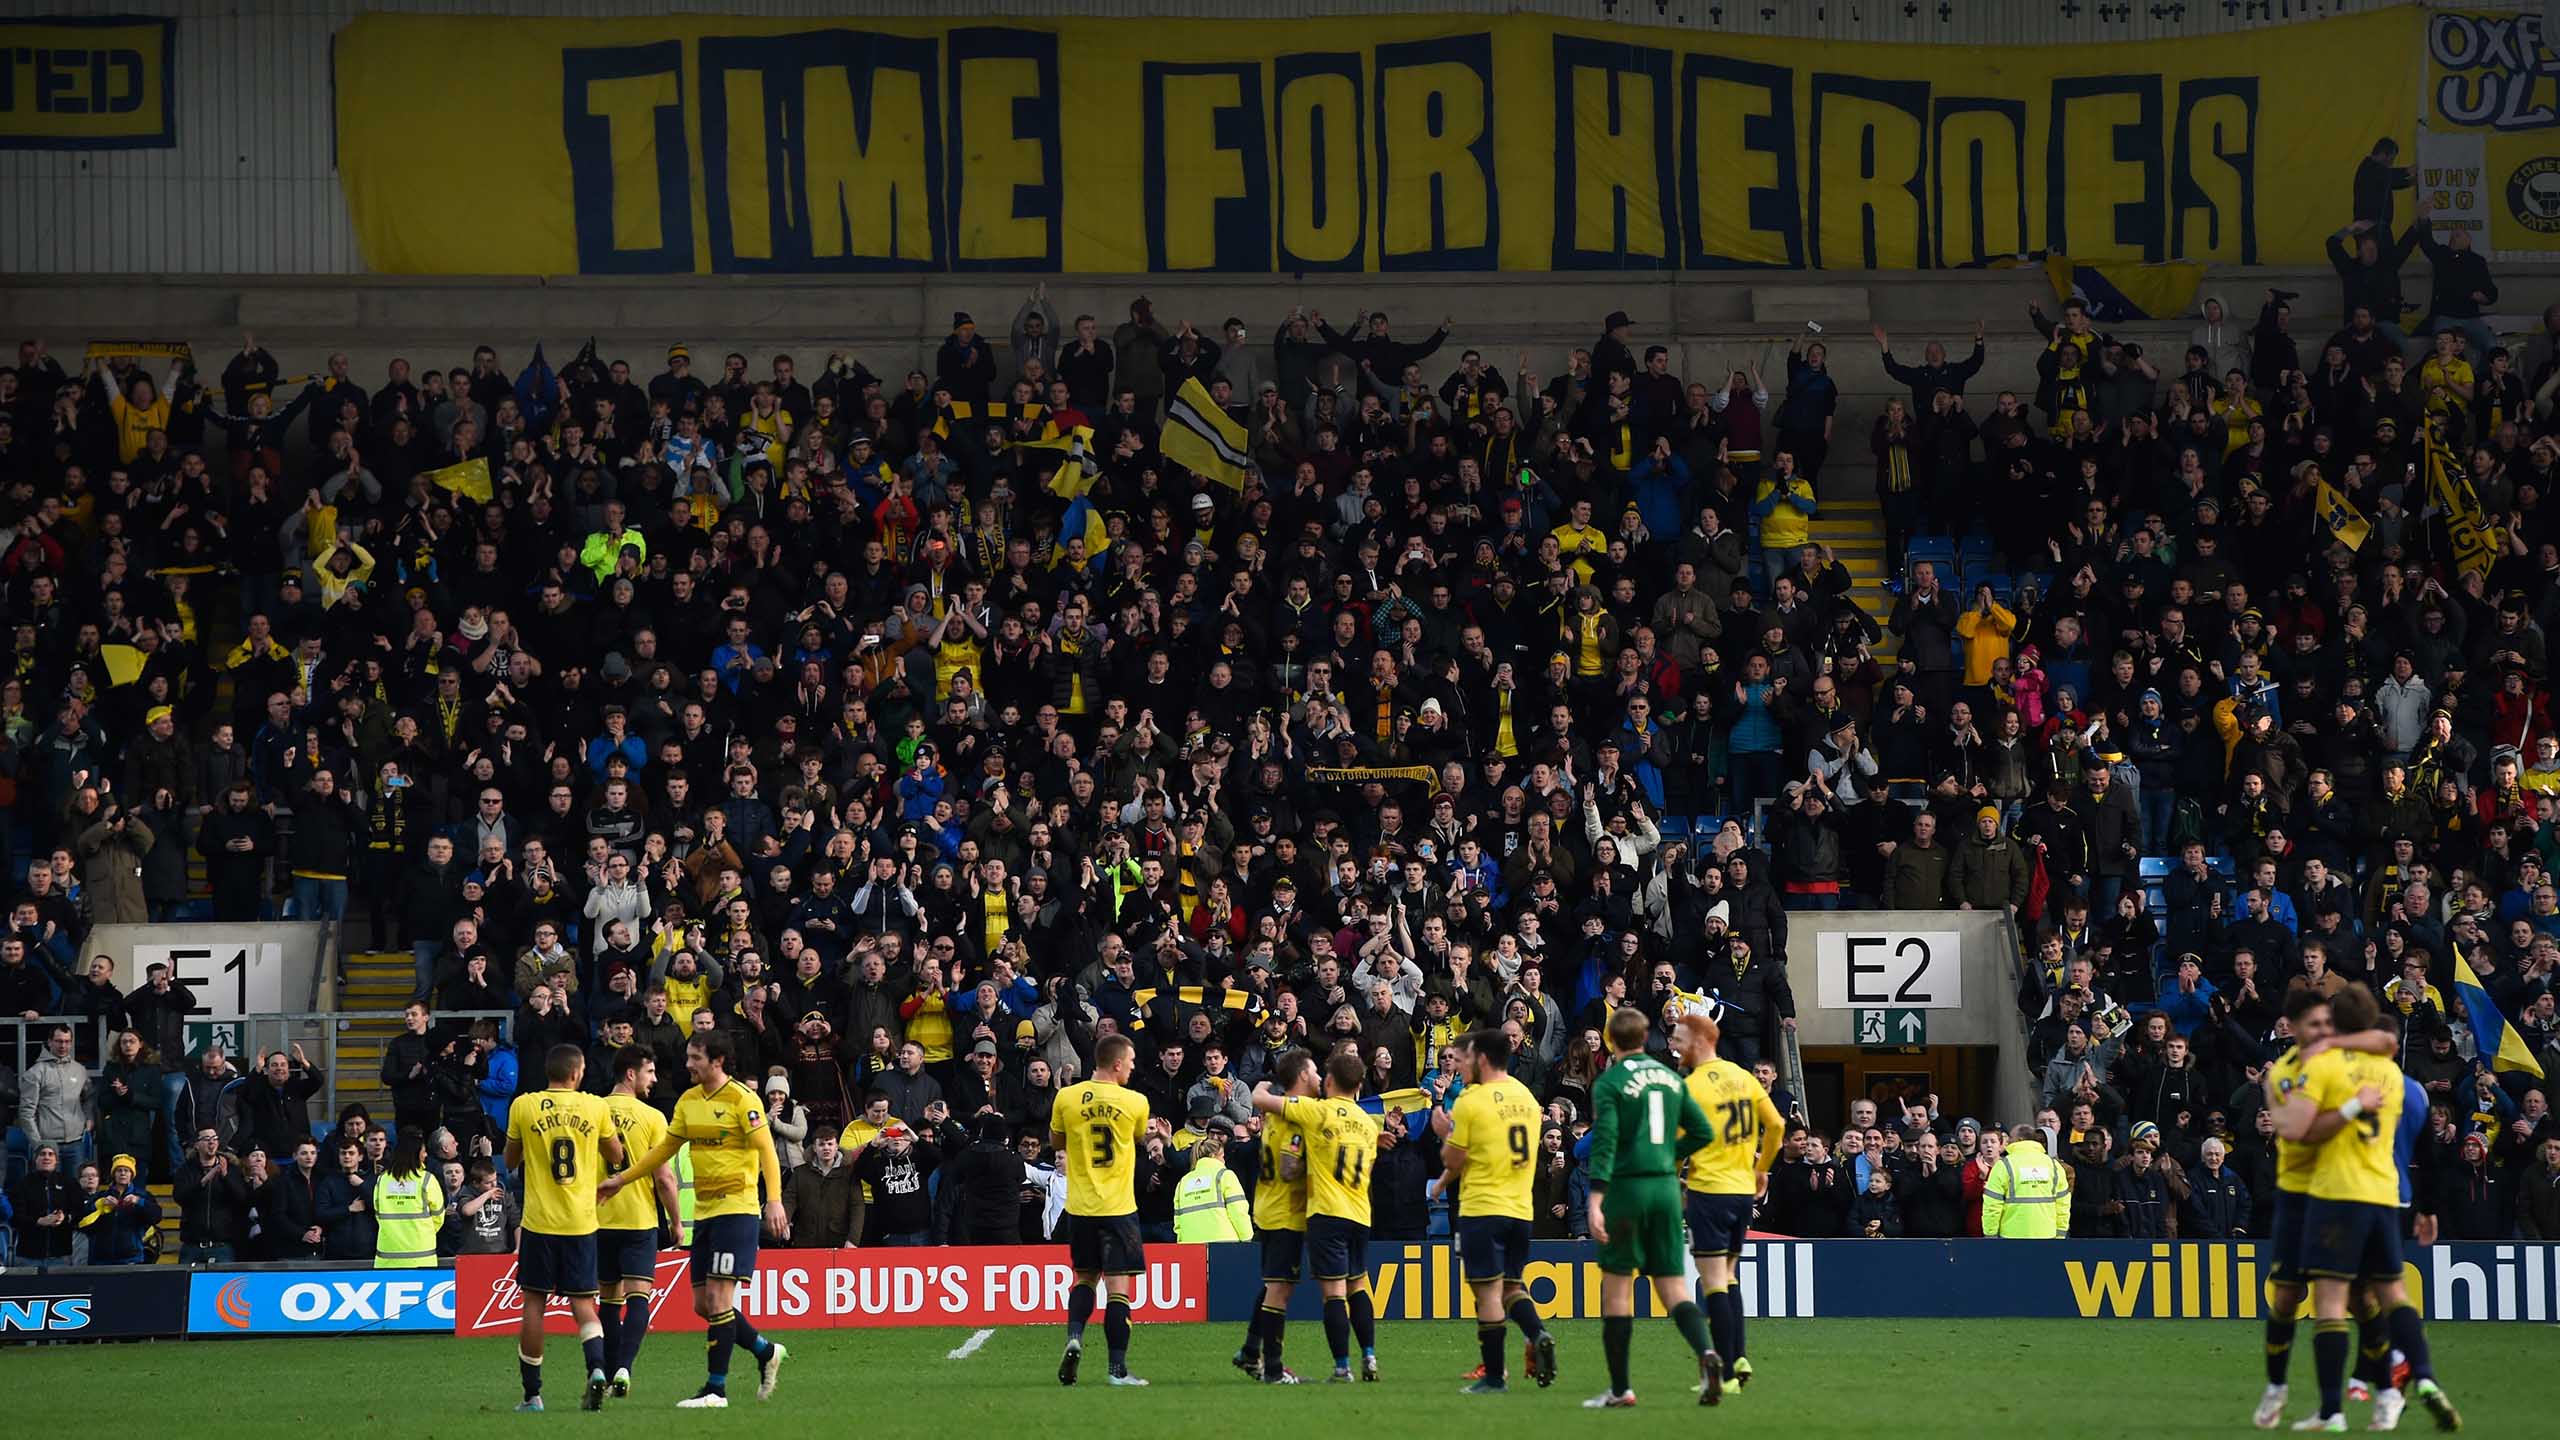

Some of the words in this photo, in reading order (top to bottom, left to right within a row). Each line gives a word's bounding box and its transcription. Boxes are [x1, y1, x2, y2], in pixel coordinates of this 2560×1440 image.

[587, 57, 1047, 261] TIME
[1162, 61, 1487, 269] FOR
[1573, 66, 2250, 269] HEROES
[2424, 168, 2480, 187] WHY
[1327, 771, 1369, 782] OXFORD
[1846, 937, 1932, 1003] E2
[530, 1113, 594, 1138] SERCOMBE
[1648, 1090, 1665, 1145] 1
[1715, 1099, 1753, 1146] 20
[550, 1135, 577, 1185] 8
[1092, 1123, 1114, 1168] 3
[1333, 1145, 1363, 1190] 11
[1508, 1124, 1530, 1168] 9
[712, 1251, 735, 1275] 10
[733, 1268, 810, 1316] HIS
[826, 1265, 968, 1316] BUD'S
[983, 1265, 1073, 1312] FOR
